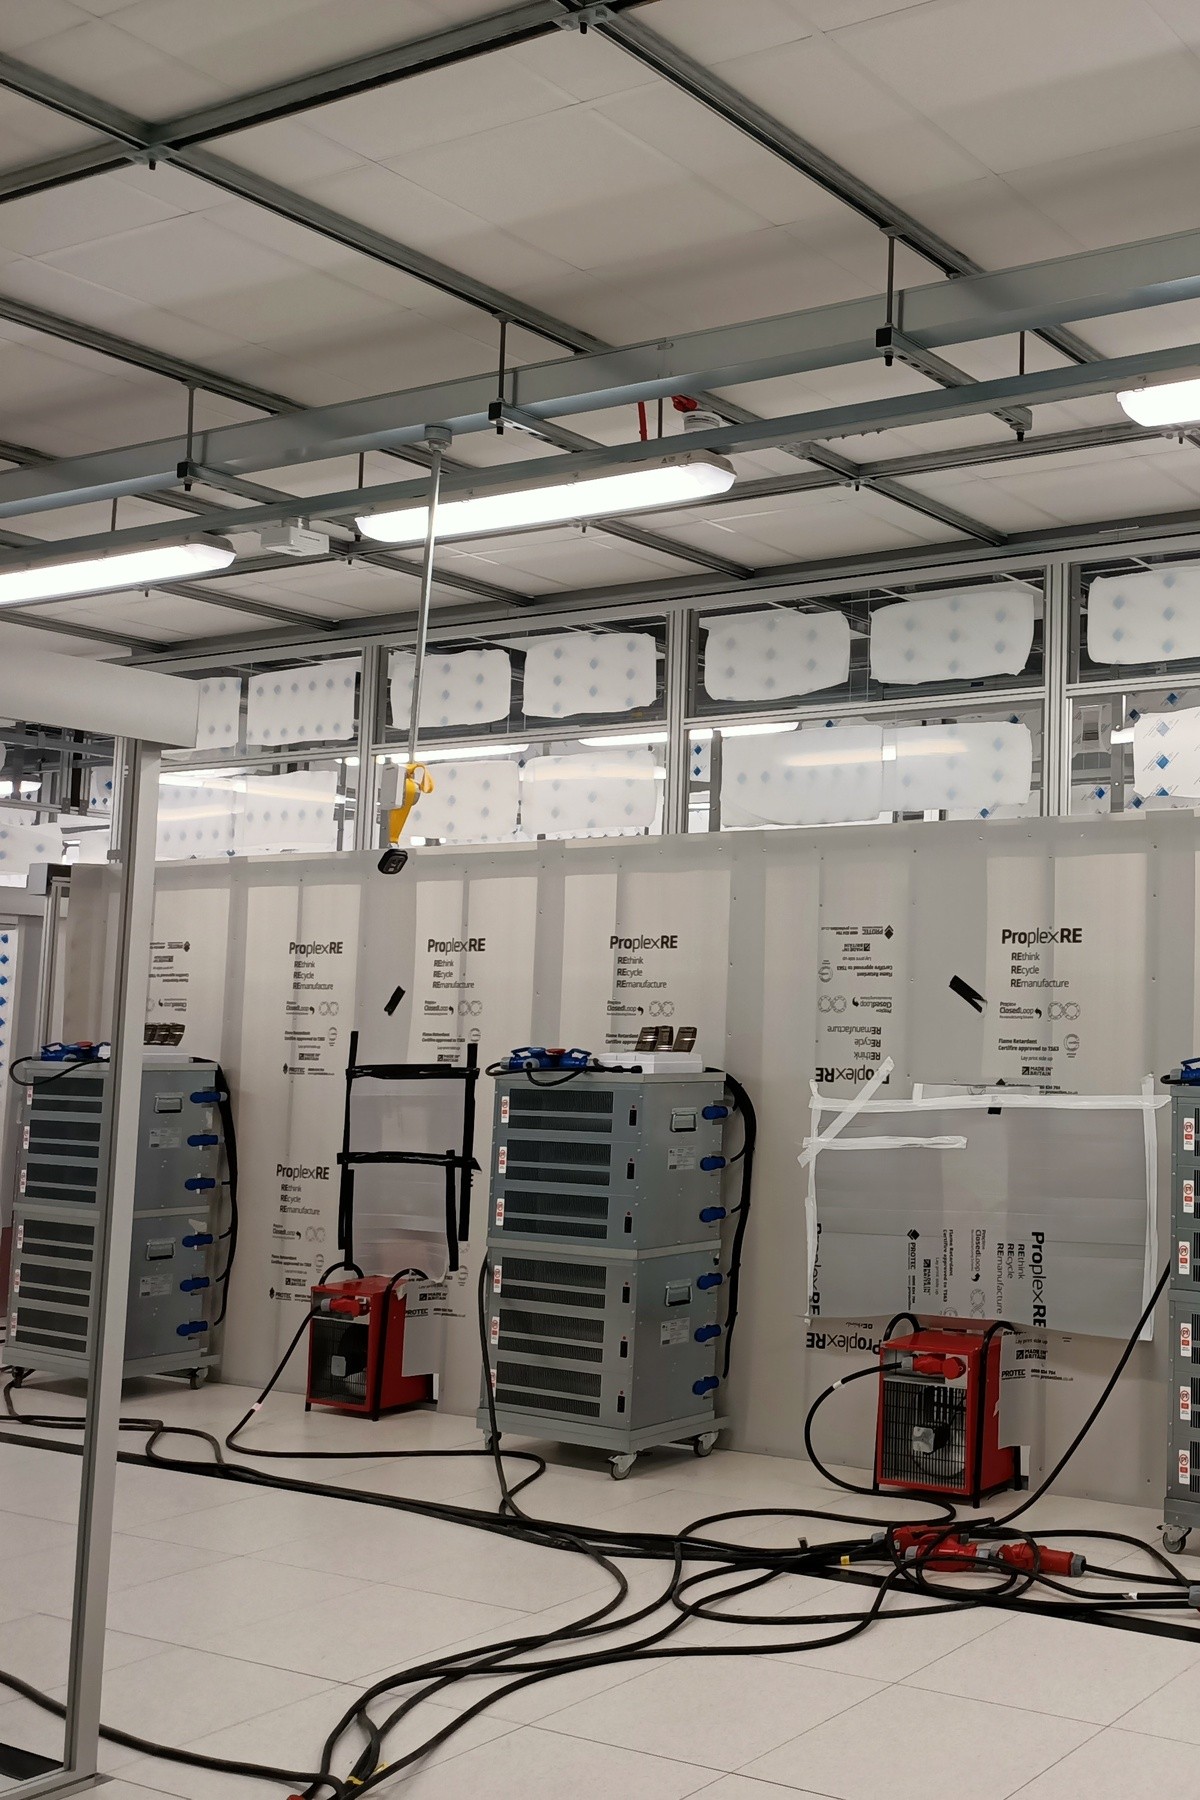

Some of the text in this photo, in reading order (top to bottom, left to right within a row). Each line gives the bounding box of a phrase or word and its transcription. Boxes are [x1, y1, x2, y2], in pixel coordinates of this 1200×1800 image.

[1002, 927, 1082, 948] ProplexRE
[427, 938, 486, 955] ProplexRE
[610, 935, 678, 952] ProplexRE
[289, 941, 344, 957] ProplexRE
[1011, 952, 1040, 960] REthink
[433, 959, 454, 967] REthink
[293, 971, 315, 980] REcycle
[433, 971, 453, 979] REcycle
[617, 968, 643, 978] REcycle
[1011, 965, 1040, 976] REcycle
[292, 982, 334, 990] REmanufacture
[616, 980, 667, 988] REmanufacture
[1010, 978, 1069, 988] REmanufacture
[827, 1026, 881, 1035] REmanufacture
[854, 1037, 881, 1048] REcycle
[853, 1051, 881, 1060] REthink
[815, 1065, 890, 1084] oplexRE
[276, 1164, 330, 1181] ProplexRE
[281, 1184, 302, 1192] REthink
[280, 1194, 301, 1204] REcycle
[280, 1205, 320, 1215] REmanufacture
[1005, 1243, 1015, 1279] REcycle
[996, 1242, 1005, 1314] REmanufacture
[1029, 1231, 1047, 1328] ProplexRE
[806, 1332, 882, 1355] ProplexRE
[1001, 1369, 1026, 1377] PROTEC
